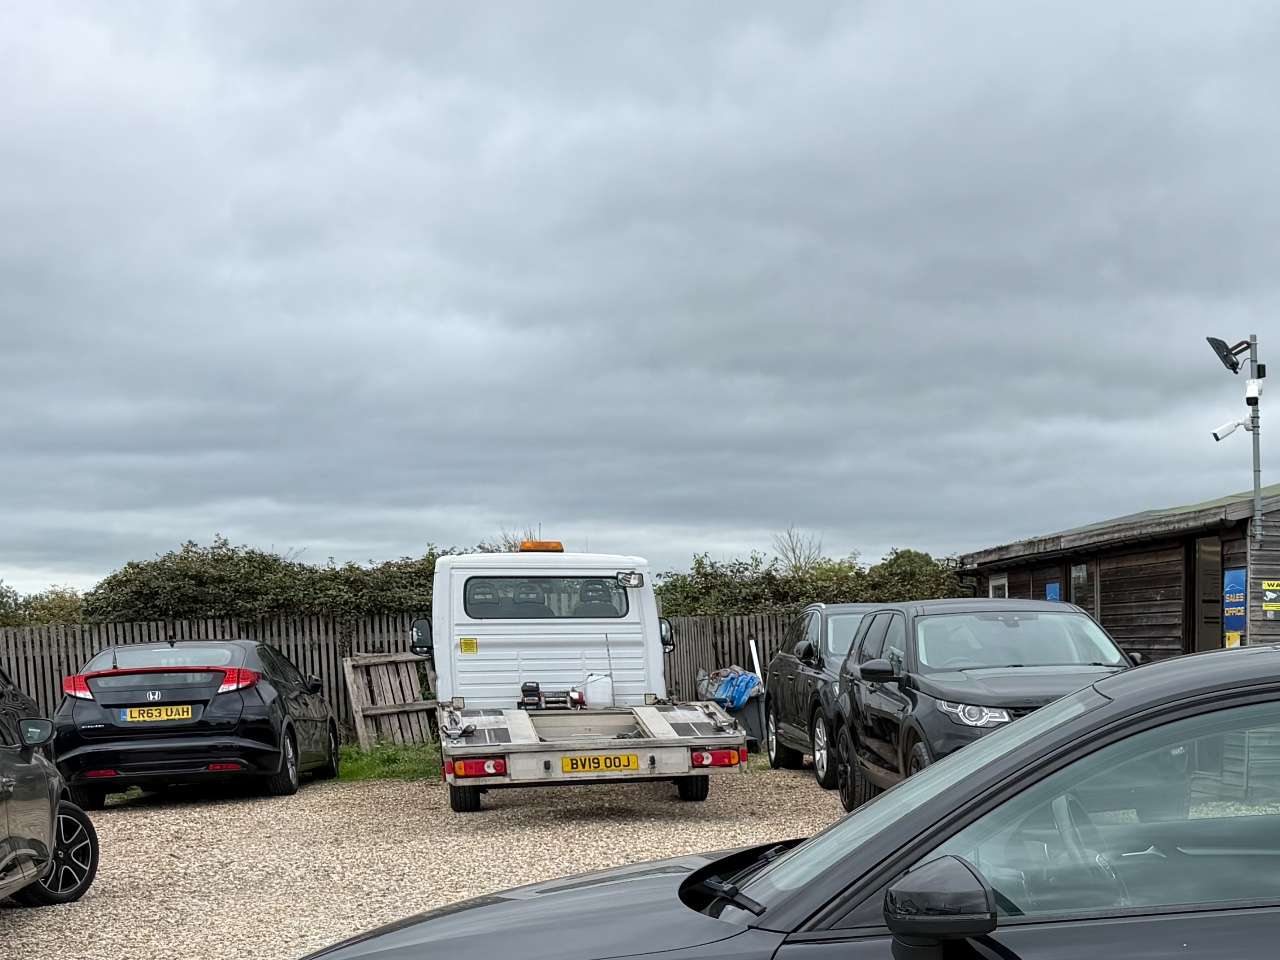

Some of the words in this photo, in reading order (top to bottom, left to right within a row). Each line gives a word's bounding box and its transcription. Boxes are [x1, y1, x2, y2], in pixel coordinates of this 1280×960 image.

[1225, 593, 1245, 602] SALES
[1225, 607, 1246, 616] OFFICE
[129, 708, 161, 719] LR63
[165, 706, 190, 717] UAH
[570, 757, 600, 769] BV19
